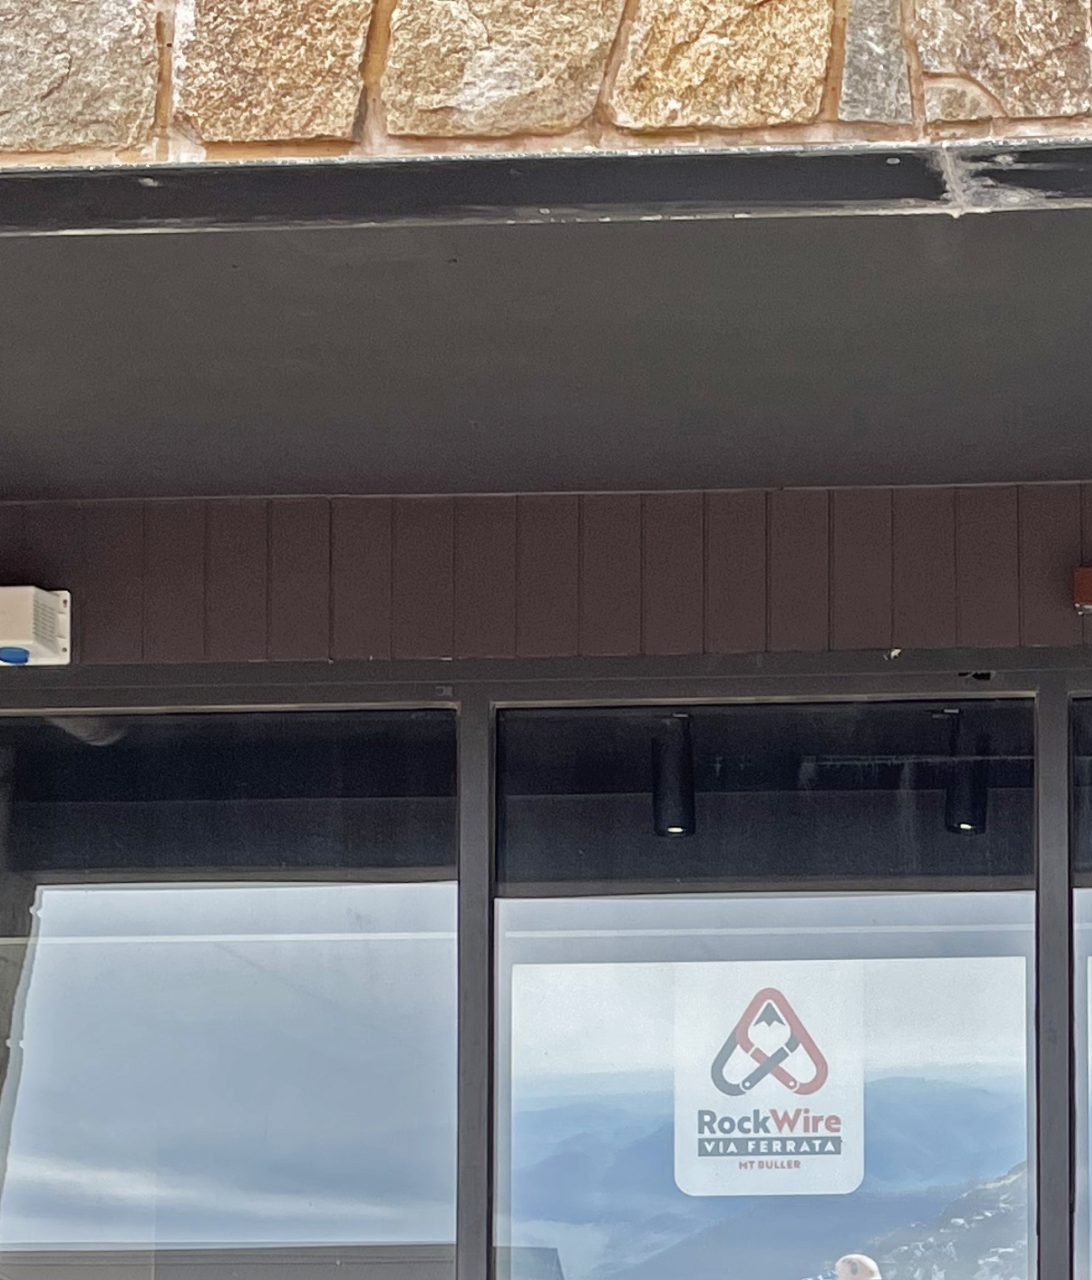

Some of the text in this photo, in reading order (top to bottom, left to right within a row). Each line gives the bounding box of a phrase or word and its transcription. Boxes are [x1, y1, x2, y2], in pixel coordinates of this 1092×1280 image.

[697, 1108, 842, 1134] RockWire
[704, 1139, 836, 1153] VIA FERRATA
[738, 1159, 801, 1170] MT BULLER
